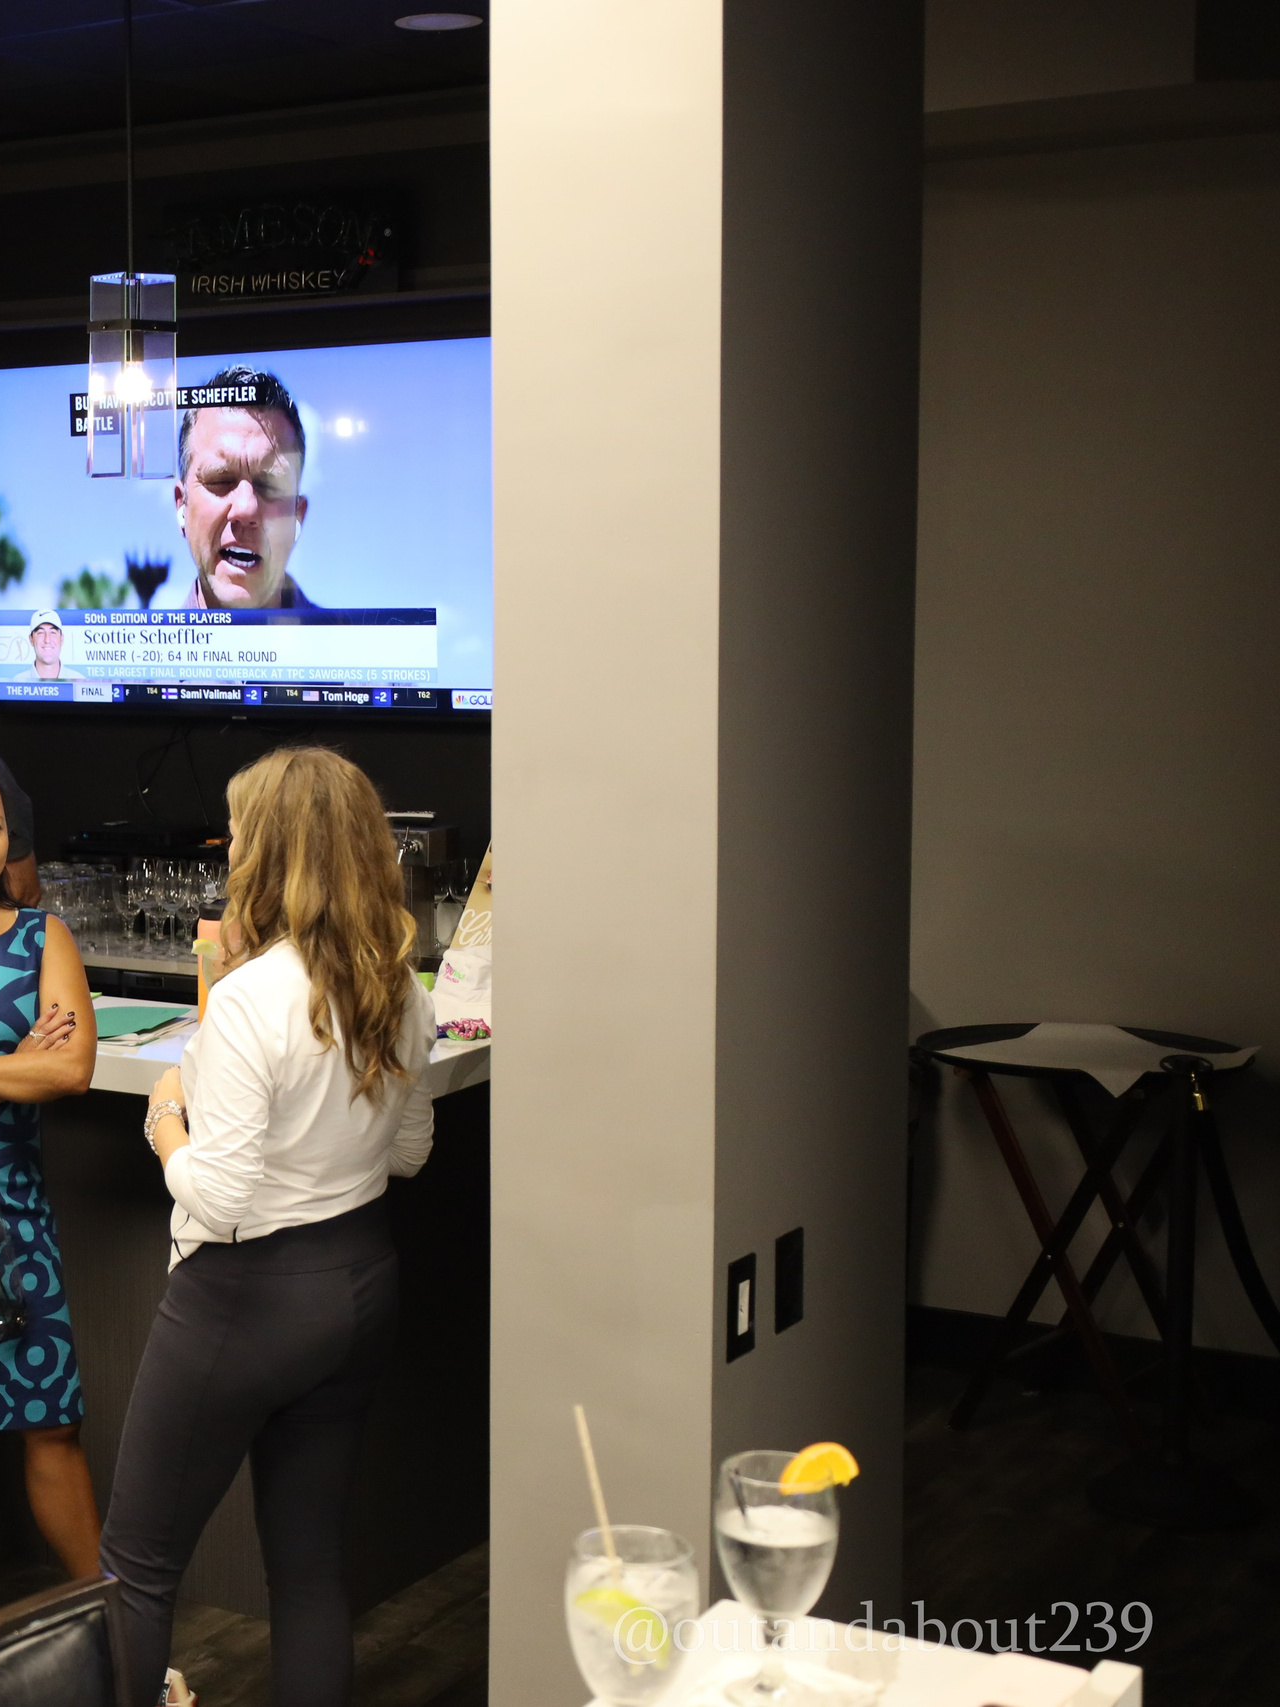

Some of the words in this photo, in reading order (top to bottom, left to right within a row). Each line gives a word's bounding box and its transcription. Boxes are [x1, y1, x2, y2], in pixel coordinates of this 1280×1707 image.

[191, 274, 245, 294] IRISH
[251, 269, 347, 292] WHISKEY
[75, 396, 92, 411] BU
[191, 386, 257, 404] SCHEFFLER
[75, 416, 114, 433] BATLE
[84, 613, 107, 624] 50th
[110, 613, 148, 624] EDITION
[151, 613, 165, 624] OF
[168, 613, 185, 624] THE
[189, 612, 232, 624] PLAYERS
[84, 628, 136, 645] Scottie
[139, 628, 213, 645] Scheffler
[85, 651, 127, 662] WINNER
[131, 650, 163, 664] (-20);
[168, 651, 182, 662] 64
[187, 651, 198, 662] IN
[203, 651, 233, 662] FINAL
[238, 651, 277, 662] ROUND
[87, 667, 106, 678] TIES
[108, 667, 147, 678] LARGEST
[150, 667, 177, 679] FINAL
[179, 668, 213, 679] ROUND
[215, 668, 267, 679] COMEBACK
[270, 668, 283, 679] AT
[287, 668, 305, 680] TPC
[308, 668, 363, 680] SAWGRASS
[366, 668, 378, 681] (5
[381, 669, 431, 681] STROKES)
[6, 685, 23, 696] THE
[24, 685, 59, 696] PLAYERS
[81, 686, 104, 697] FINAL
[180, 688, 202, 699] Sami
[203, 689, 241, 700] Valimaki
[246, 690, 258, 700] -2
[264, 691, 268, 699] F
[286, 689, 298, 697] T54
[322, 691, 343, 702] Tom
[344, 691, 369, 704] Hoge
[374, 692, 387, 702] -2
[393, 692, 398, 701] F
[417, 691, 431, 699] T62
